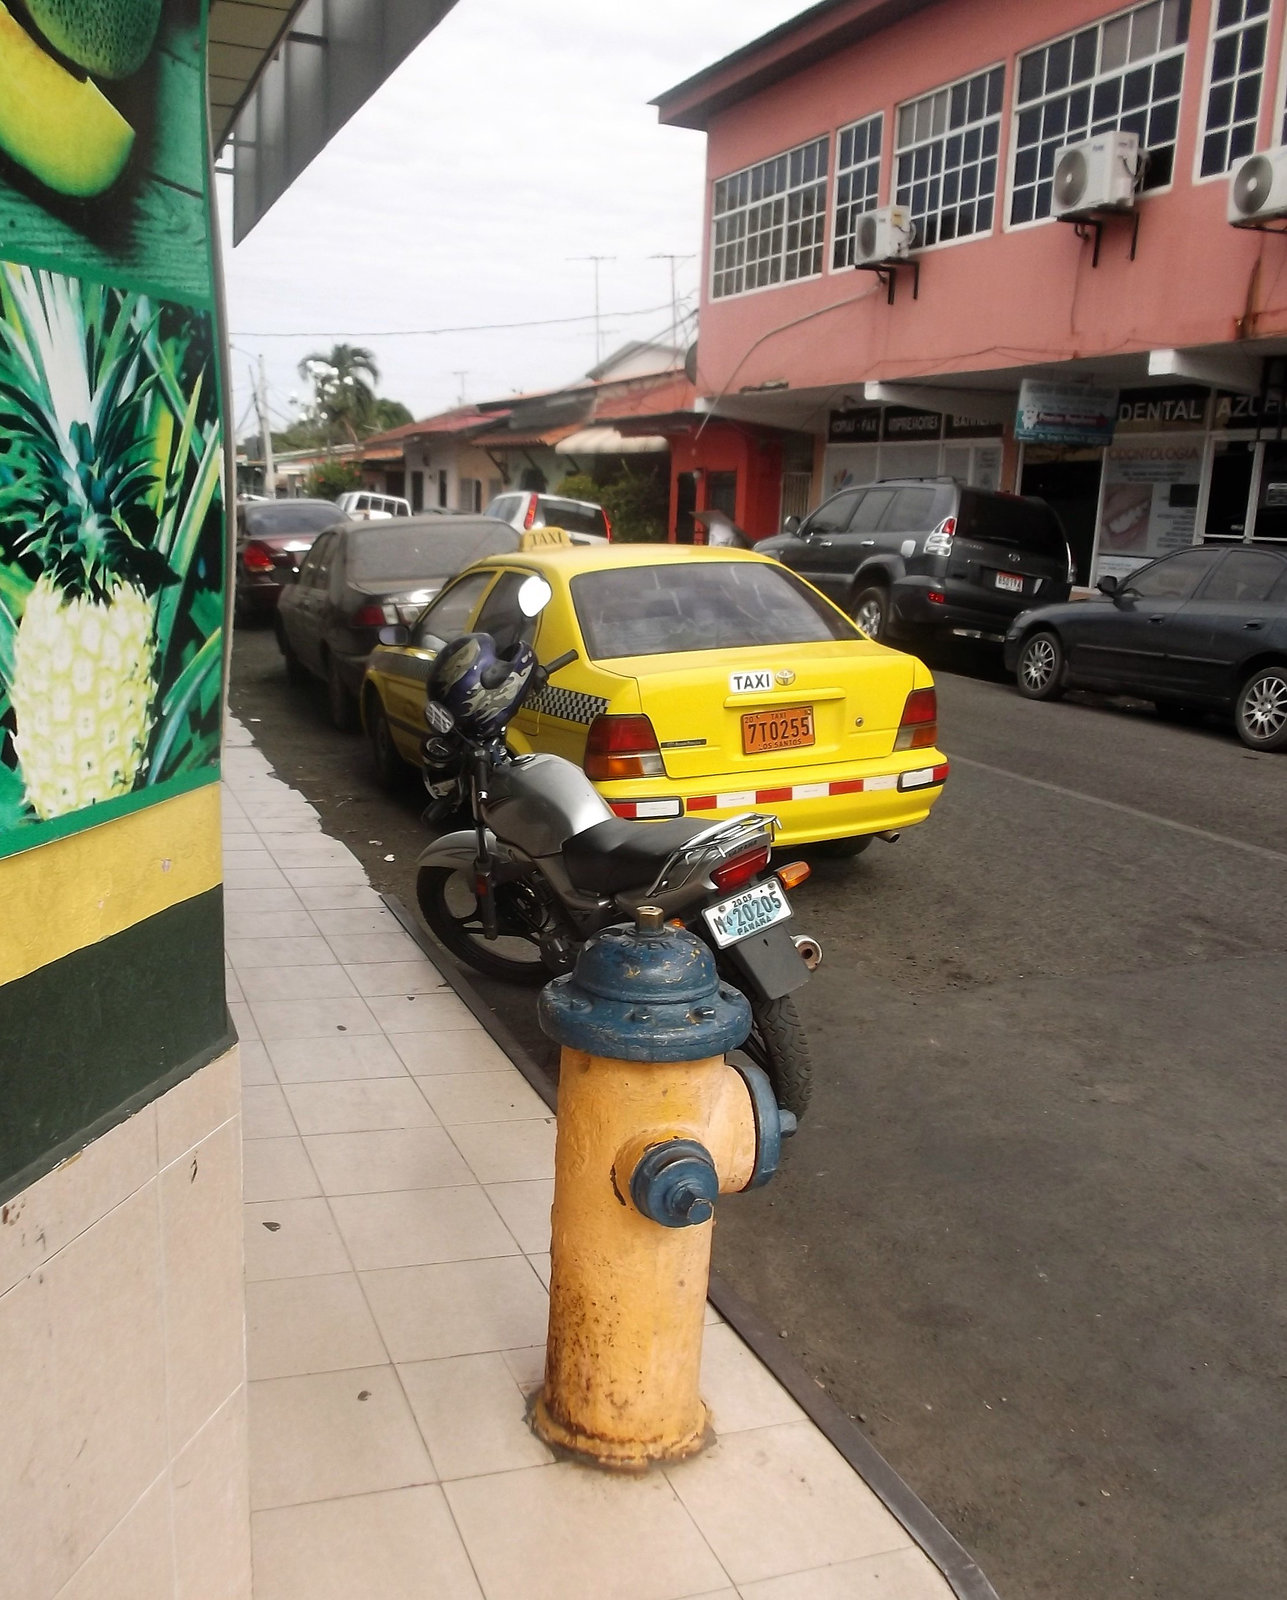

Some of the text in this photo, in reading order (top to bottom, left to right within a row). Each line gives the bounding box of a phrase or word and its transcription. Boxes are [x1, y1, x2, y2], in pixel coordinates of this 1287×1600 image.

[1119, 399, 1202, 422] DENTAL
[863, 418, 877, 432] FAX
[529, 532, 562, 546] TAXI
[733, 673, 770, 690] TAXI
[744, 711, 787, 724] 20 TAXI
[747, 716, 810, 745] 7T0255
[758, 738, 802, 751] LOS SANTOS
[732, 890, 782, 927] 20205
[737, 915, 773, 936] PANAMA
